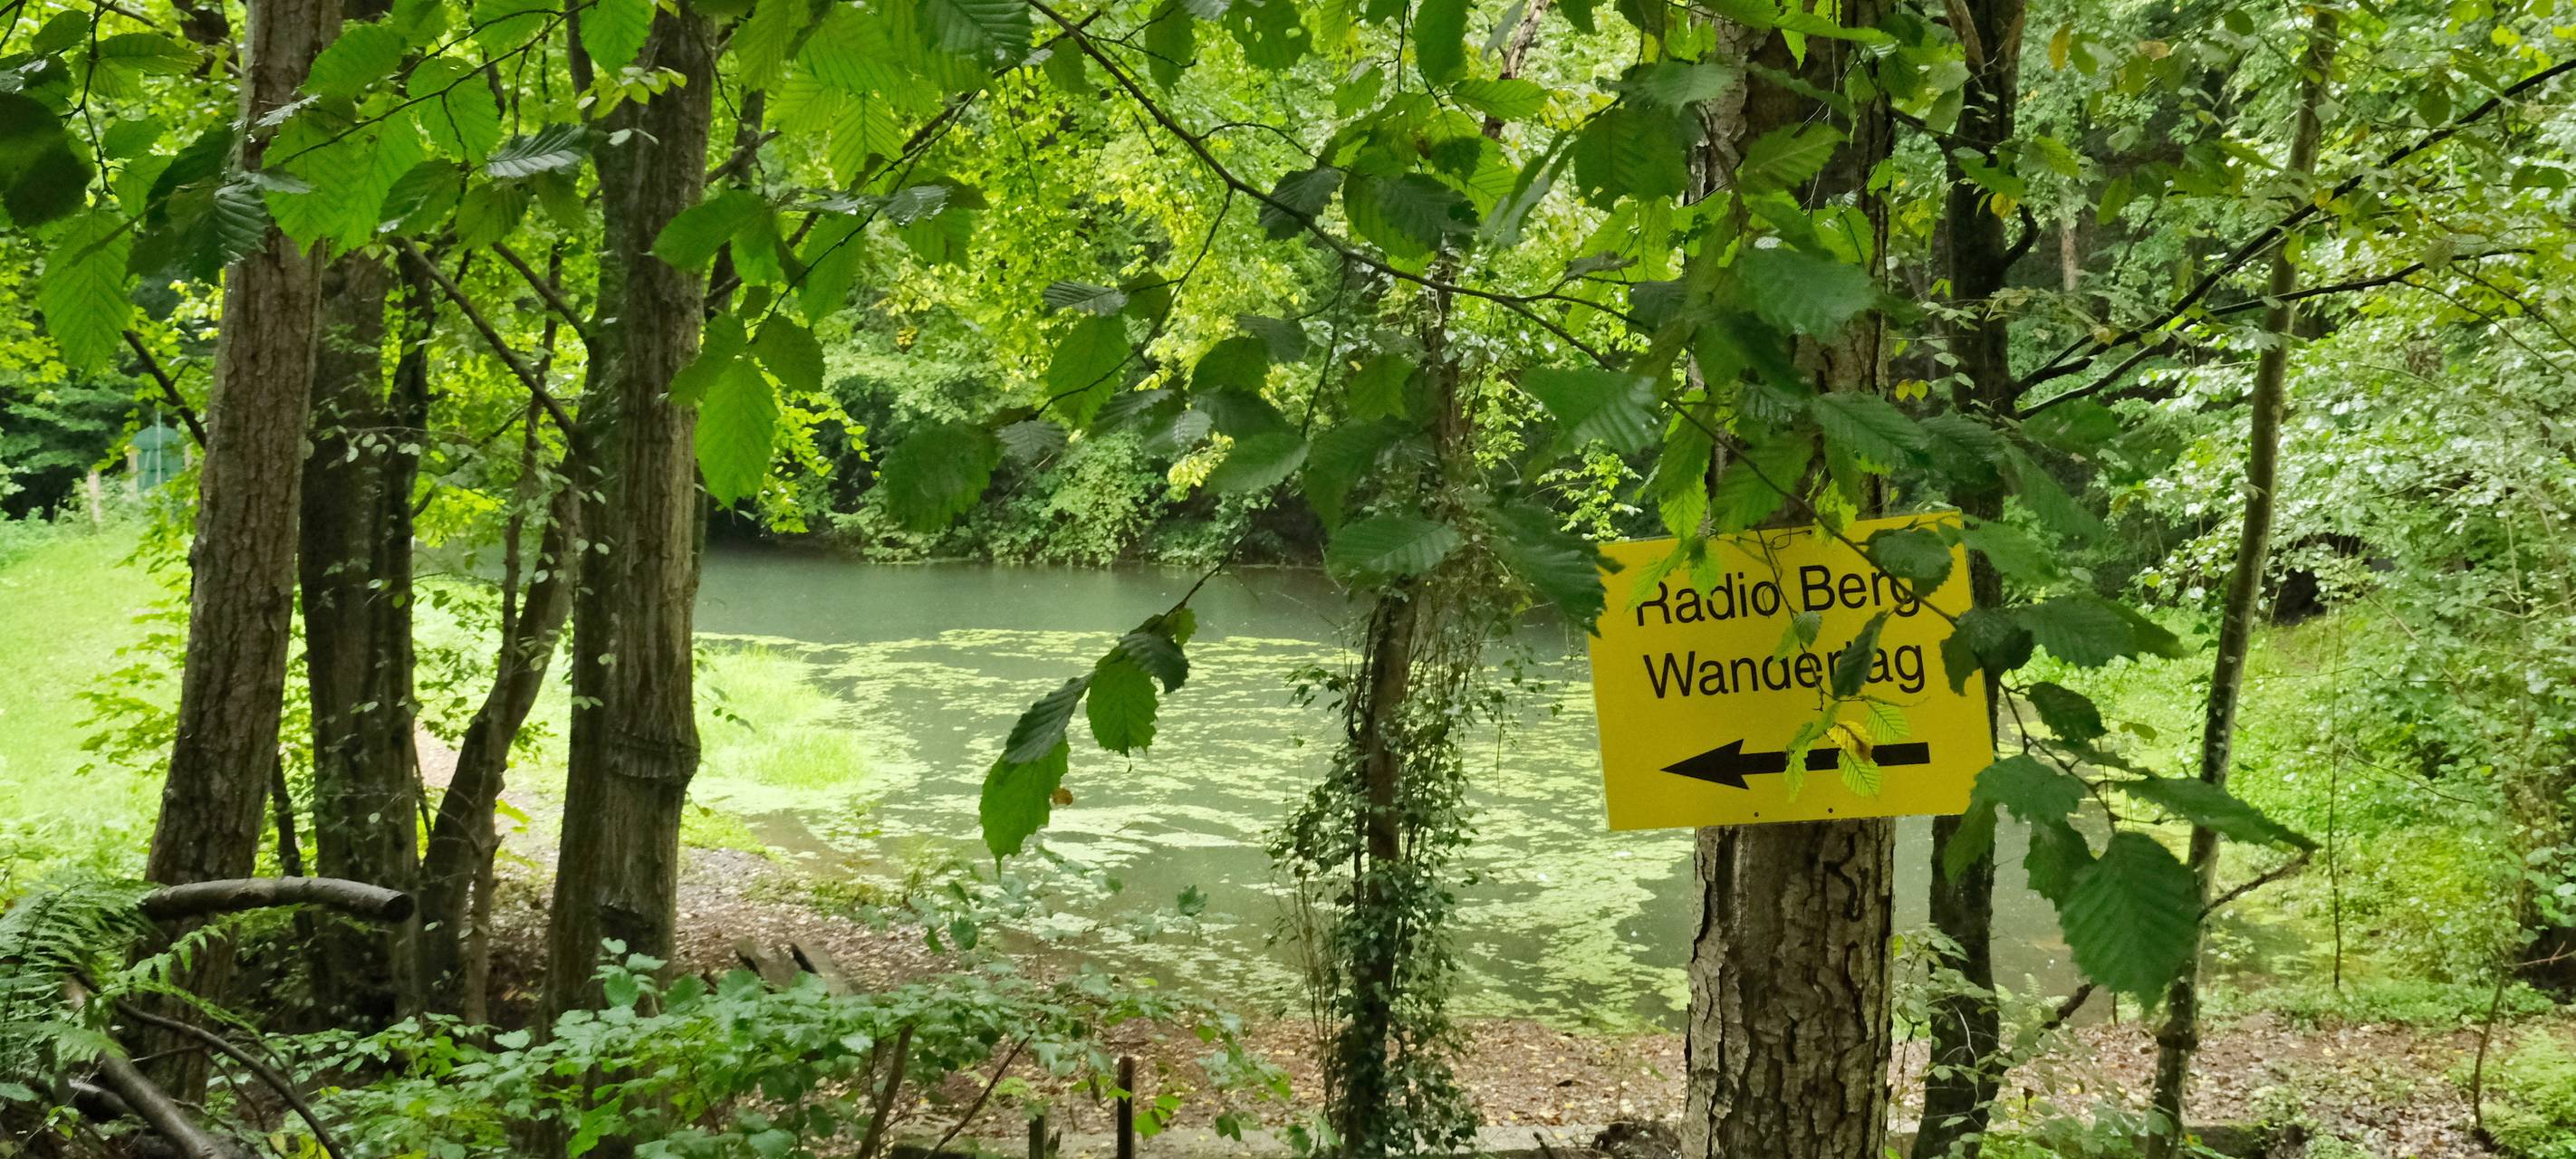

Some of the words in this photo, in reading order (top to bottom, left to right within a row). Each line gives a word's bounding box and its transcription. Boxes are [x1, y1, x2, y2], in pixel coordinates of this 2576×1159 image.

[1636, 571, 1781, 627] Radio
[1799, 564, 1920, 618] Berg
[1642, 640, 1926, 699] Wanderag
